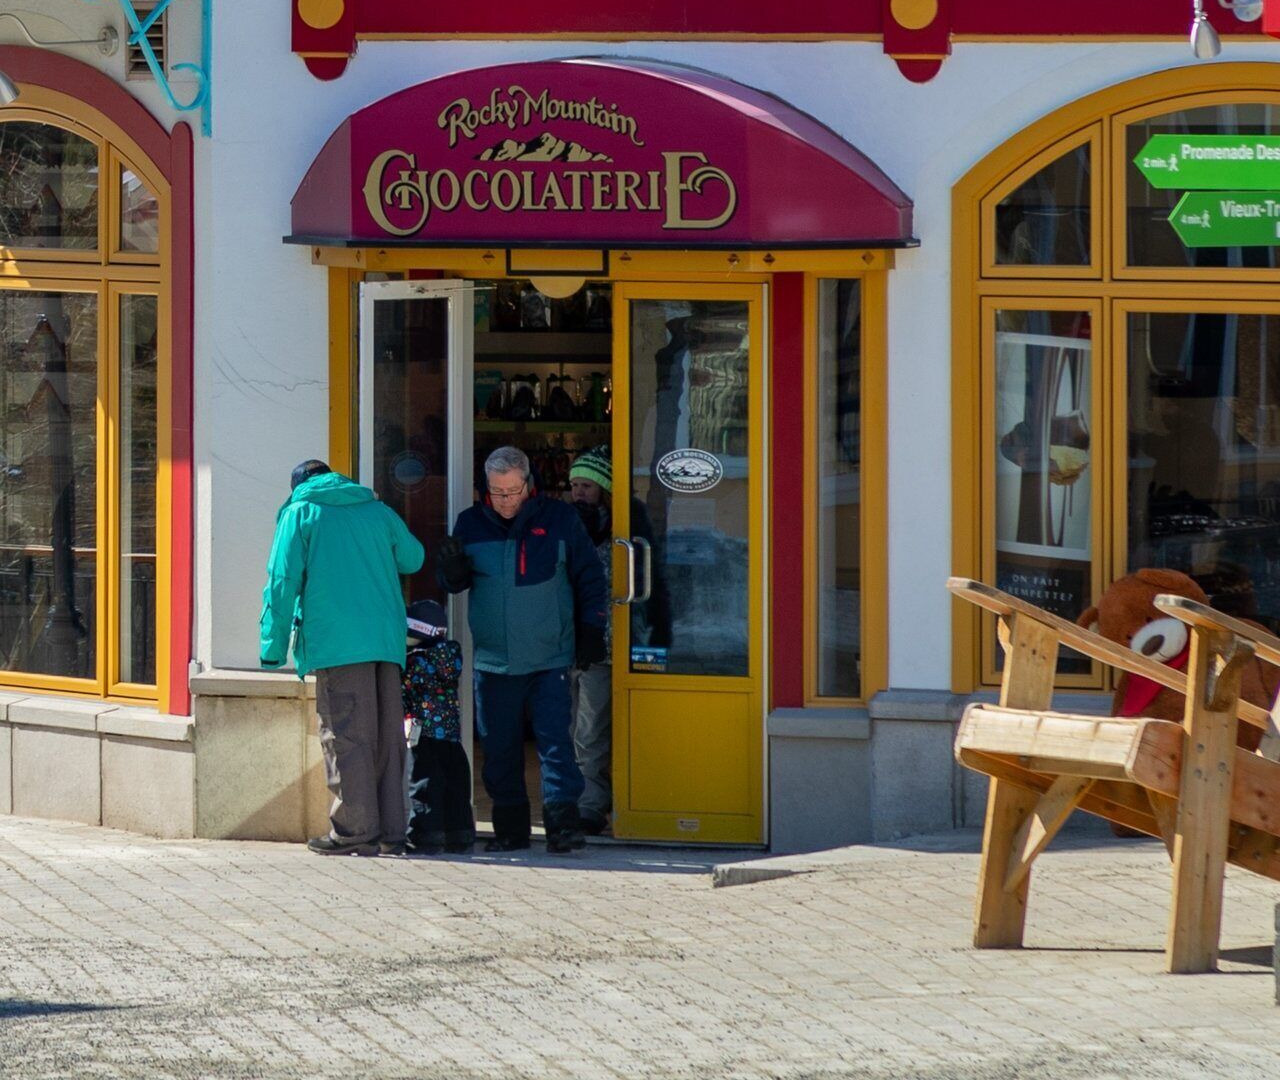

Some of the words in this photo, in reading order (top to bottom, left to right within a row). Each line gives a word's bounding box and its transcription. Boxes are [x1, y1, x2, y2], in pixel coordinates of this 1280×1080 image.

[437, 87, 520, 148] Rocky
[508, 84, 645, 146] Mountain
[1181, 144, 1254, 160] Promenade
[1143, 158, 1150, 168] 2
[362, 149, 737, 237] CHOCOLATERIE
[1012, 574, 1028, 583] ON
[1034, 576, 1060, 587] FAIT
